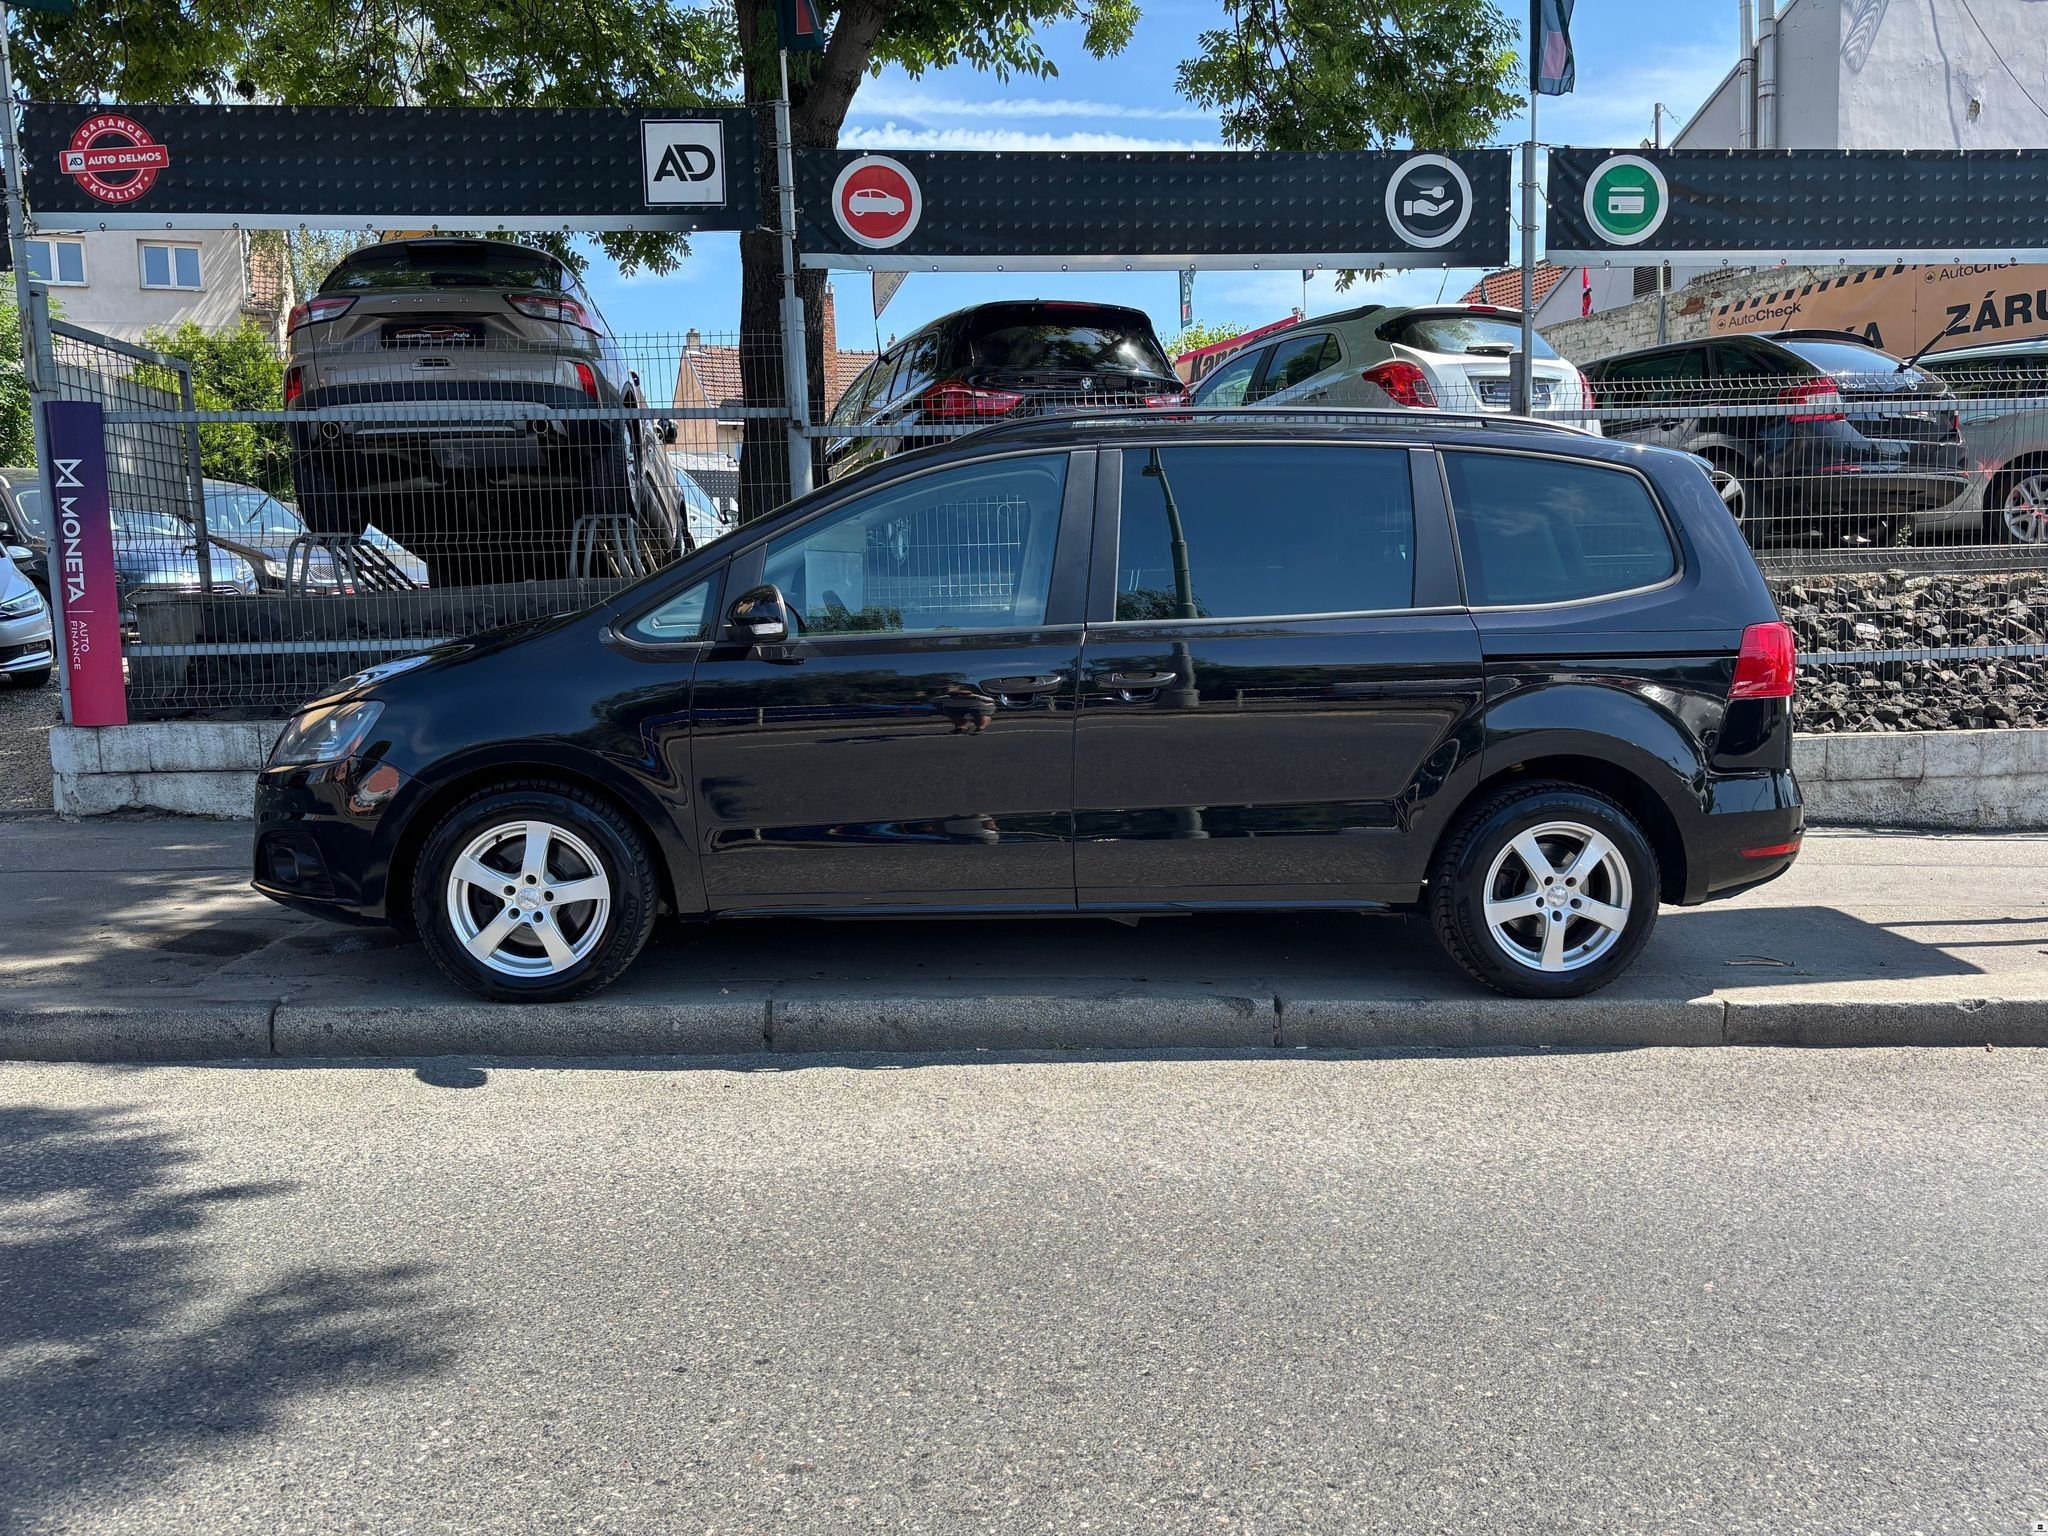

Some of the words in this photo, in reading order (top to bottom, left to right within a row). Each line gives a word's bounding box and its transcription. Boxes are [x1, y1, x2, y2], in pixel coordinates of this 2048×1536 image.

[81, 118, 143, 139] GARANCE
[88, 155, 117, 166] AUTO
[118, 152, 162, 163] DELMOS
[653, 144, 716, 182] AD
[89, 183, 144, 199] KVALITY
[1939, 264, 2023, 281] AutoC
[1729, 302, 1802, 328] AutoCheck
[60, 497, 86, 604] MONETA
[70, 620, 82, 670] FINANCE
[78, 620, 90, 653] AUTO
